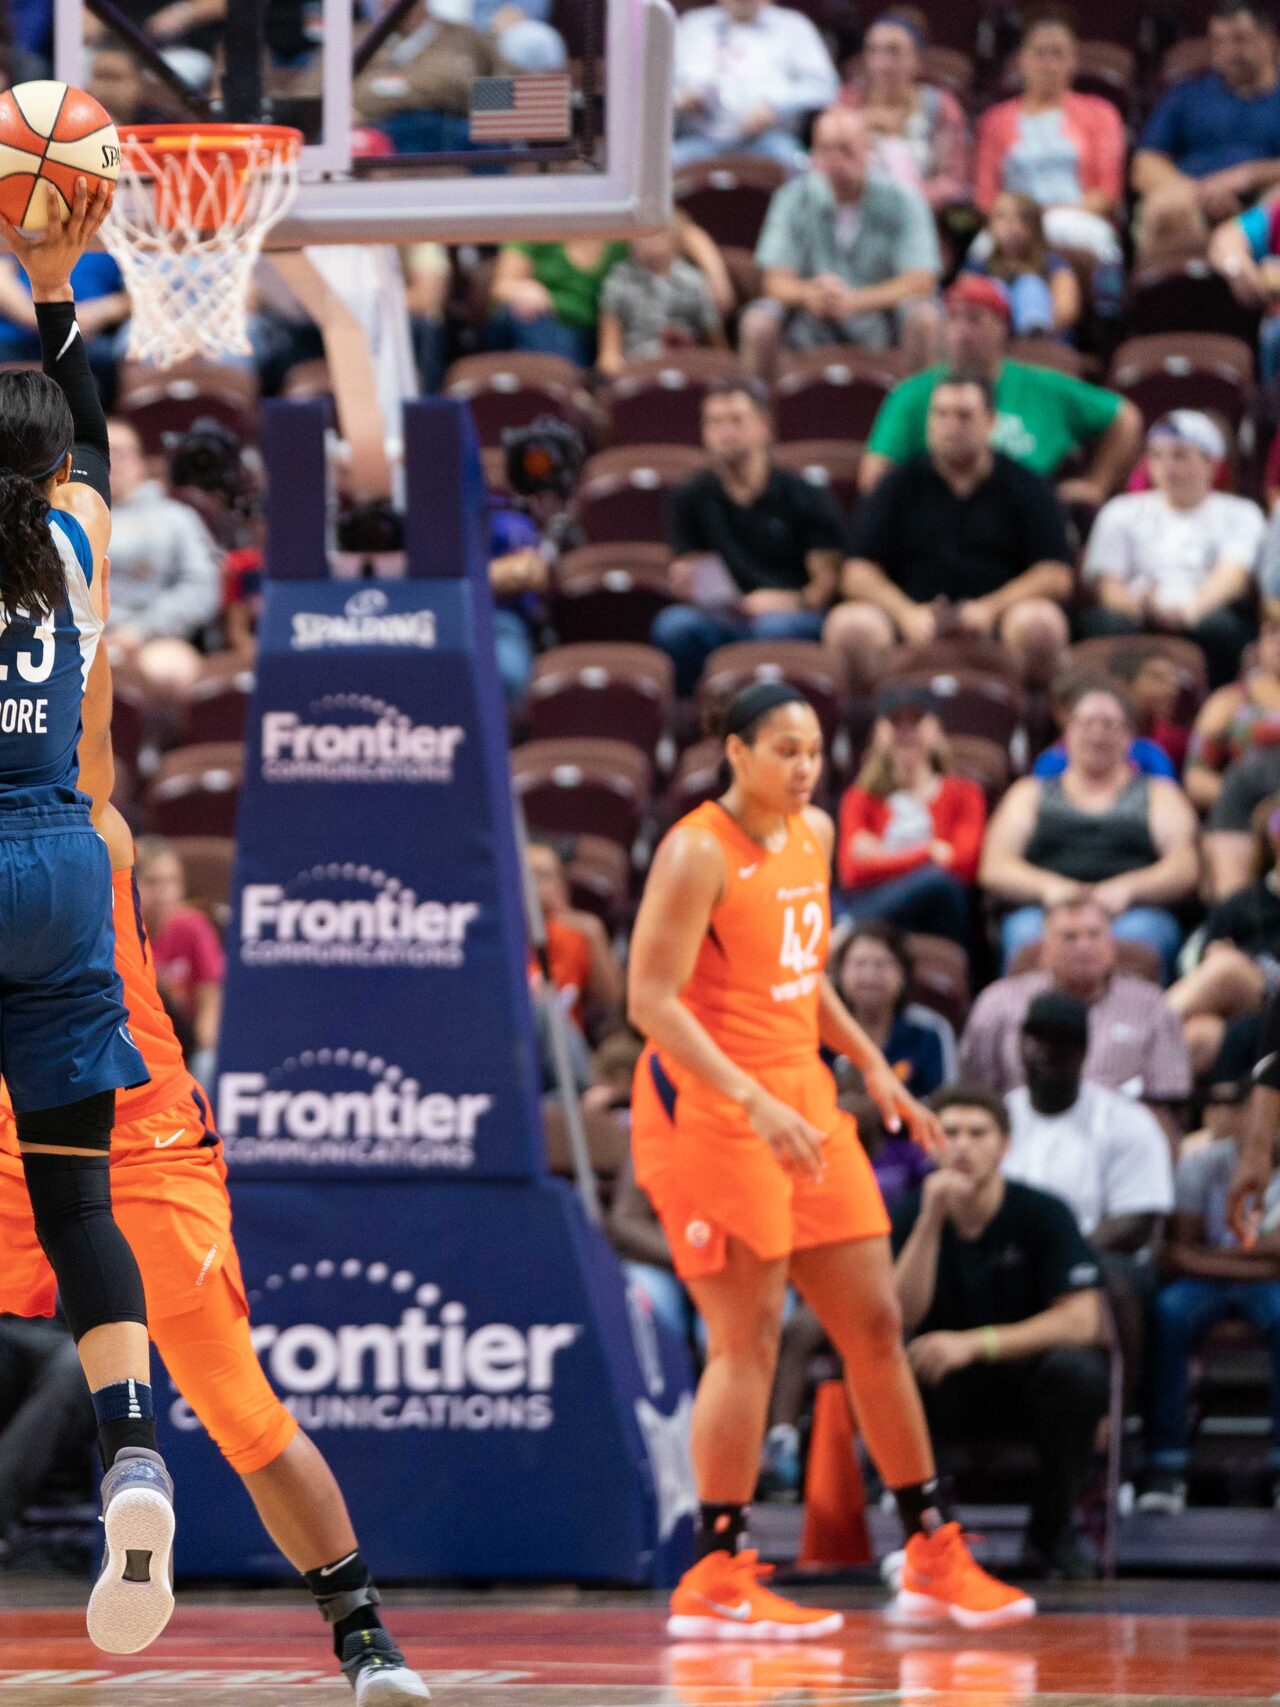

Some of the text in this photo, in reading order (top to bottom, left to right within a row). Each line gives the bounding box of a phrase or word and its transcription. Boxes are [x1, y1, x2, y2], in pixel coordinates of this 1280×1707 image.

[291, 610, 436, 650] SPALDING
[261, 710, 465, 762] Frontier
[240, 883, 481, 942] Frontier
[779, 901, 823, 974] 42
[219, 1071, 494, 1140] Frontier
[250, 1300, 583, 1392] rontier
